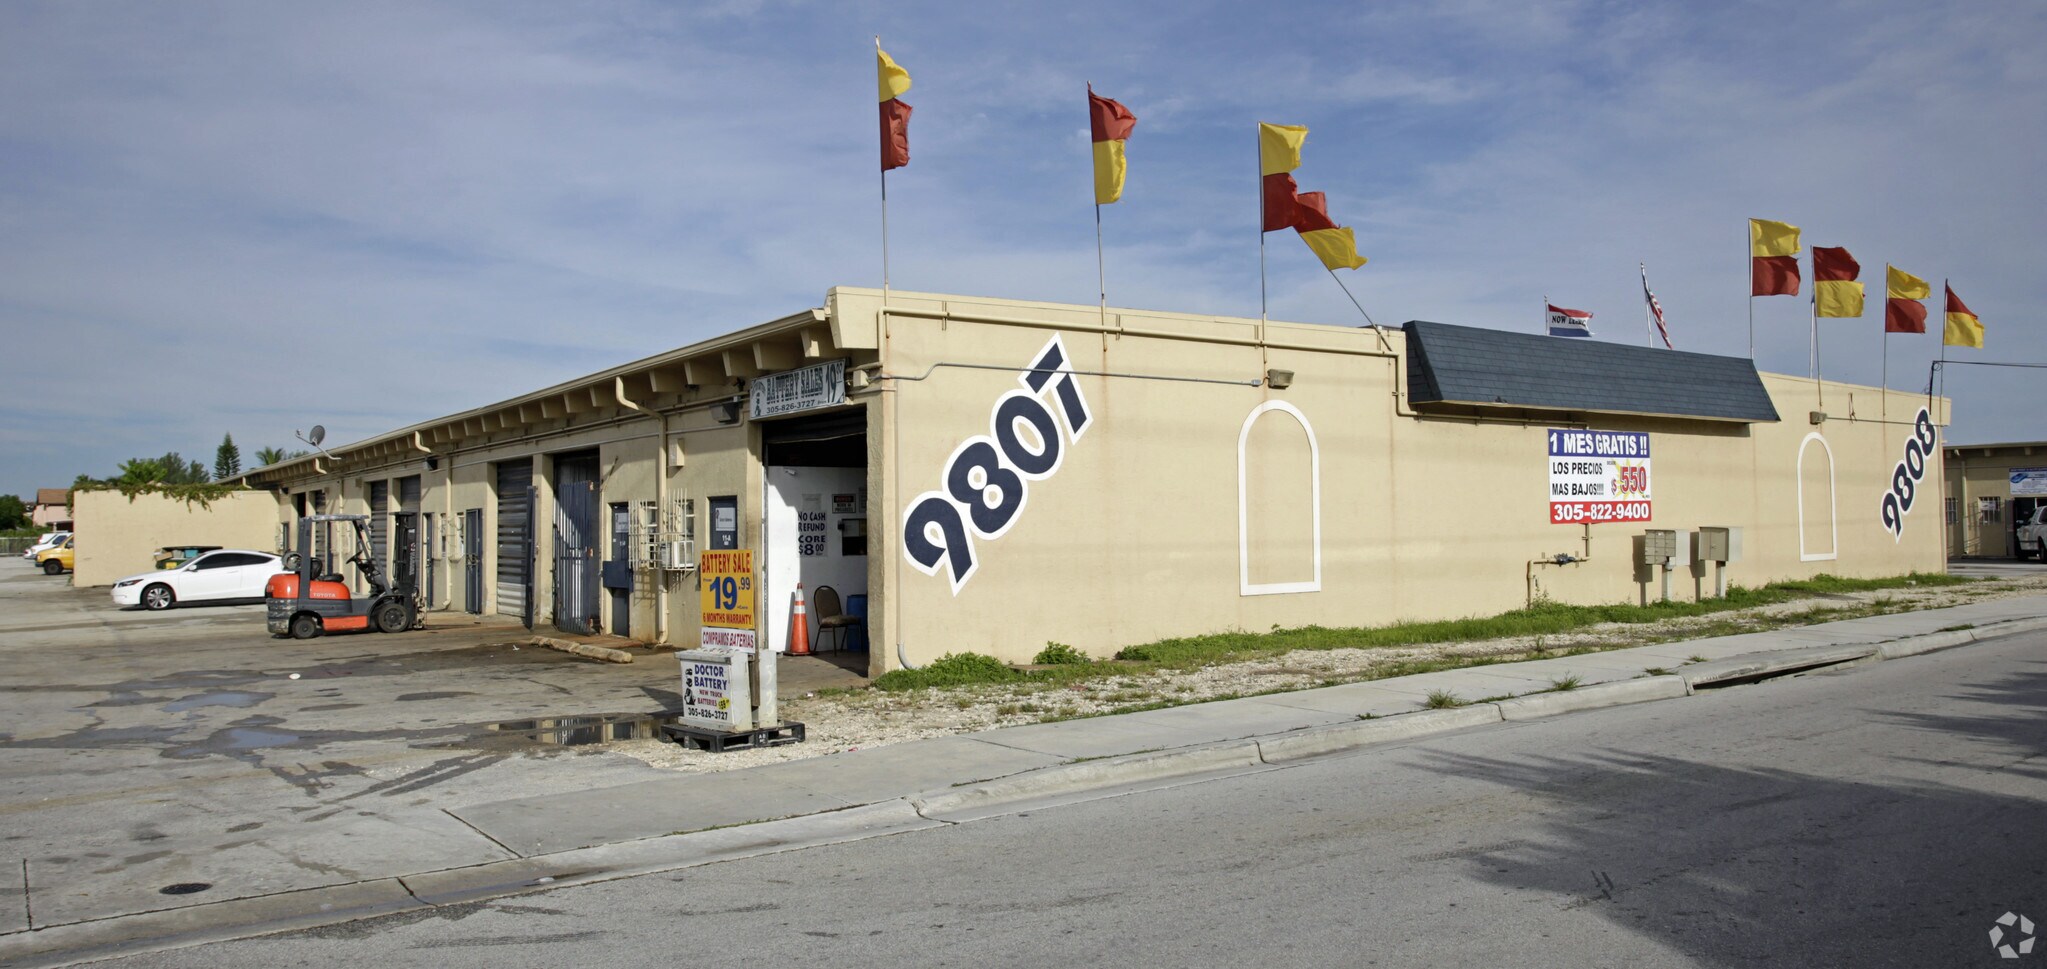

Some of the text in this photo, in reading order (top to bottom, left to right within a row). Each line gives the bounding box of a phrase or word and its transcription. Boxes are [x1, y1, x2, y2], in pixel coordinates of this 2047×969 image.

[1552, 316, 1567, 324] NOW
[766, 372, 799, 402] BATTERY
[801, 367, 823, 396] SALES
[826, 363, 836, 403] 19
[766, 400, 815, 414] 305-826-3727
[1550, 432, 1558, 453] 1
[1563, 433, 1594, 454] MES
[1596, 434, 1637, 455] GRATIS
[904, 338, 1090, 590] 9807
[1553, 462, 1603, 475] LOS PRECIOS
[1620, 466, 1647, 493] 550
[1882, 407, 1936, 540] 9808
[1552, 483, 1568, 495] MAS
[798, 512, 825, 521] NO CASH
[1554, 503, 1649, 520] 305-822-9400
[798, 522, 825, 532] REFUND
[798, 535, 825, 543] CORE
[702, 553, 750, 573] BATTERY SALE
[706, 613, 725, 623] MONTHS
[726, 613, 752, 625] WARRANTY
[703, 632, 754, 648] COMPRAMOS BATERIAS
[694, 664, 724, 677] DOCTOR
[694, 676, 727, 690] BATTERY
[698, 698, 717, 706] BATTERIES
[688, 707, 728, 720] 305-826-3727
